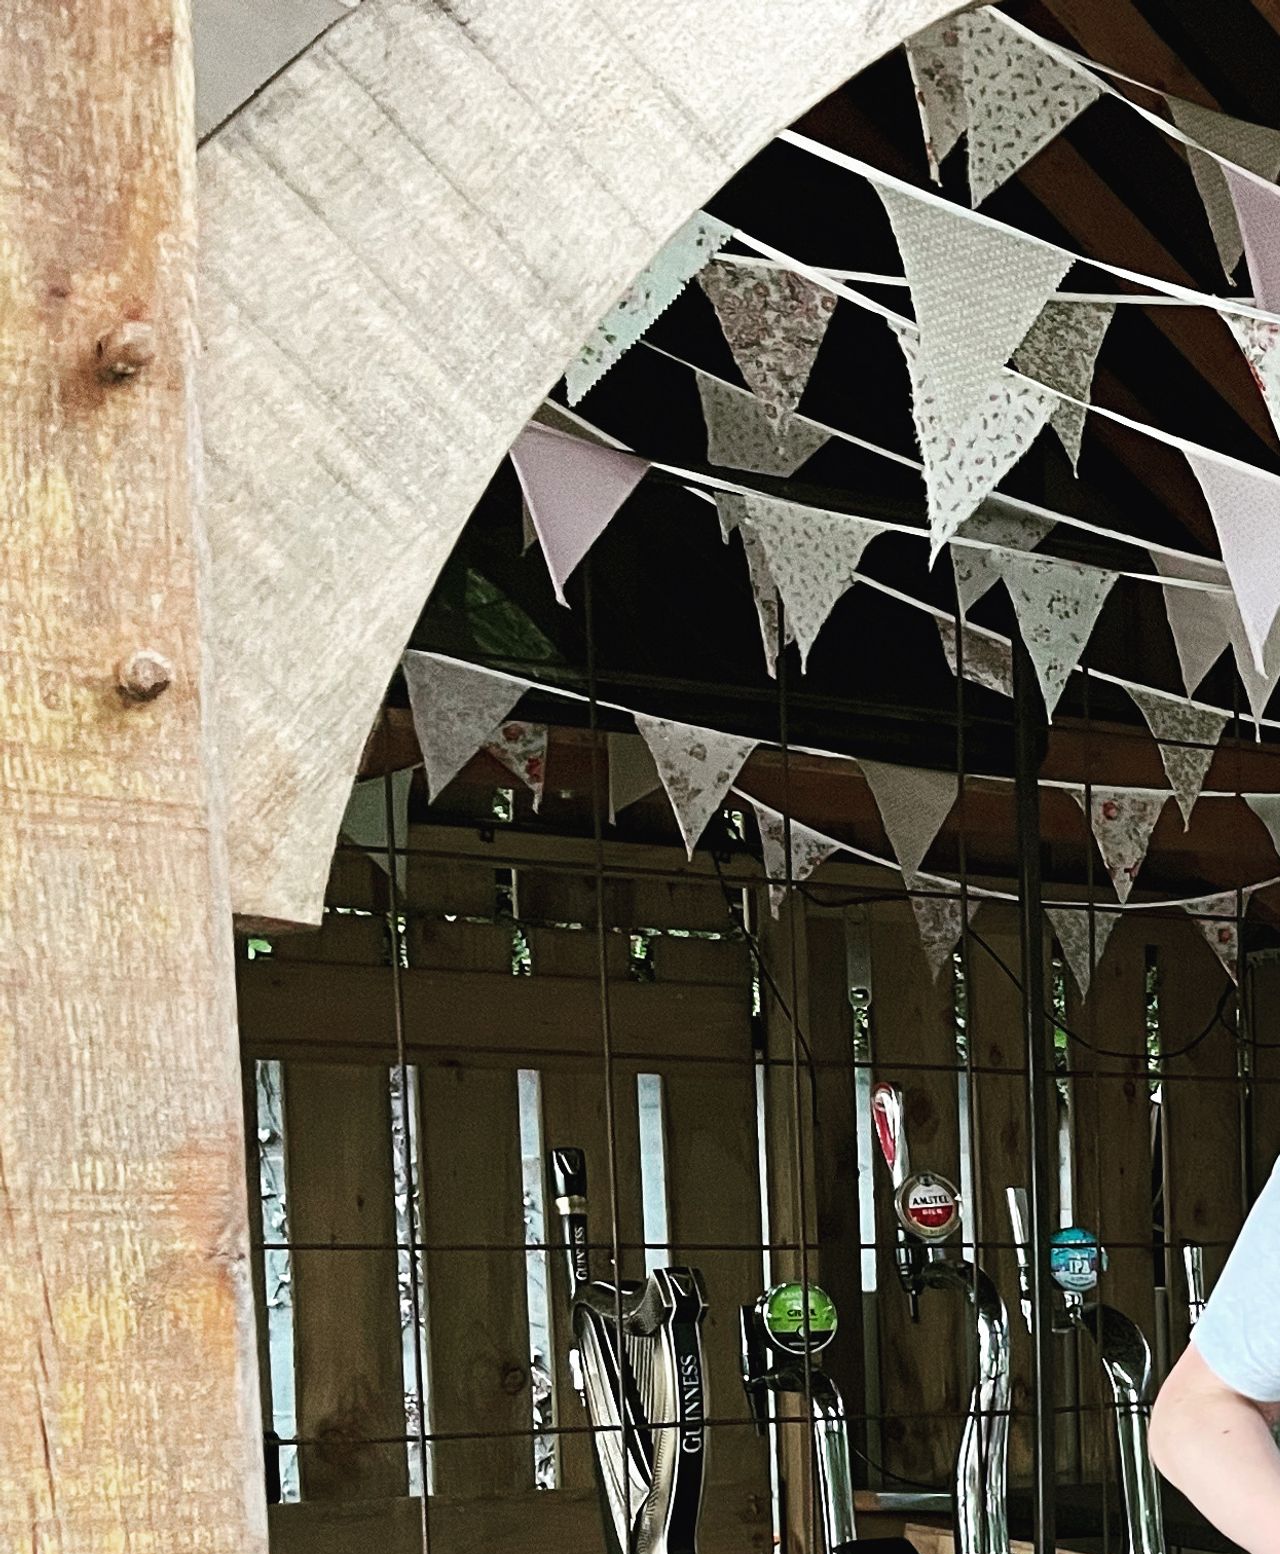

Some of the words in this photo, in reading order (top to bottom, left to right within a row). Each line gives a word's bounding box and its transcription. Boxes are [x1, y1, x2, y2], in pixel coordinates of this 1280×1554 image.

[912, 1195, 949, 1205] AMSTEL
[574, 1226, 588, 1281] GUINESS
[1069, 1259, 1091, 1274] IPA
[680, 1354, 702, 1453] GUINNESS
